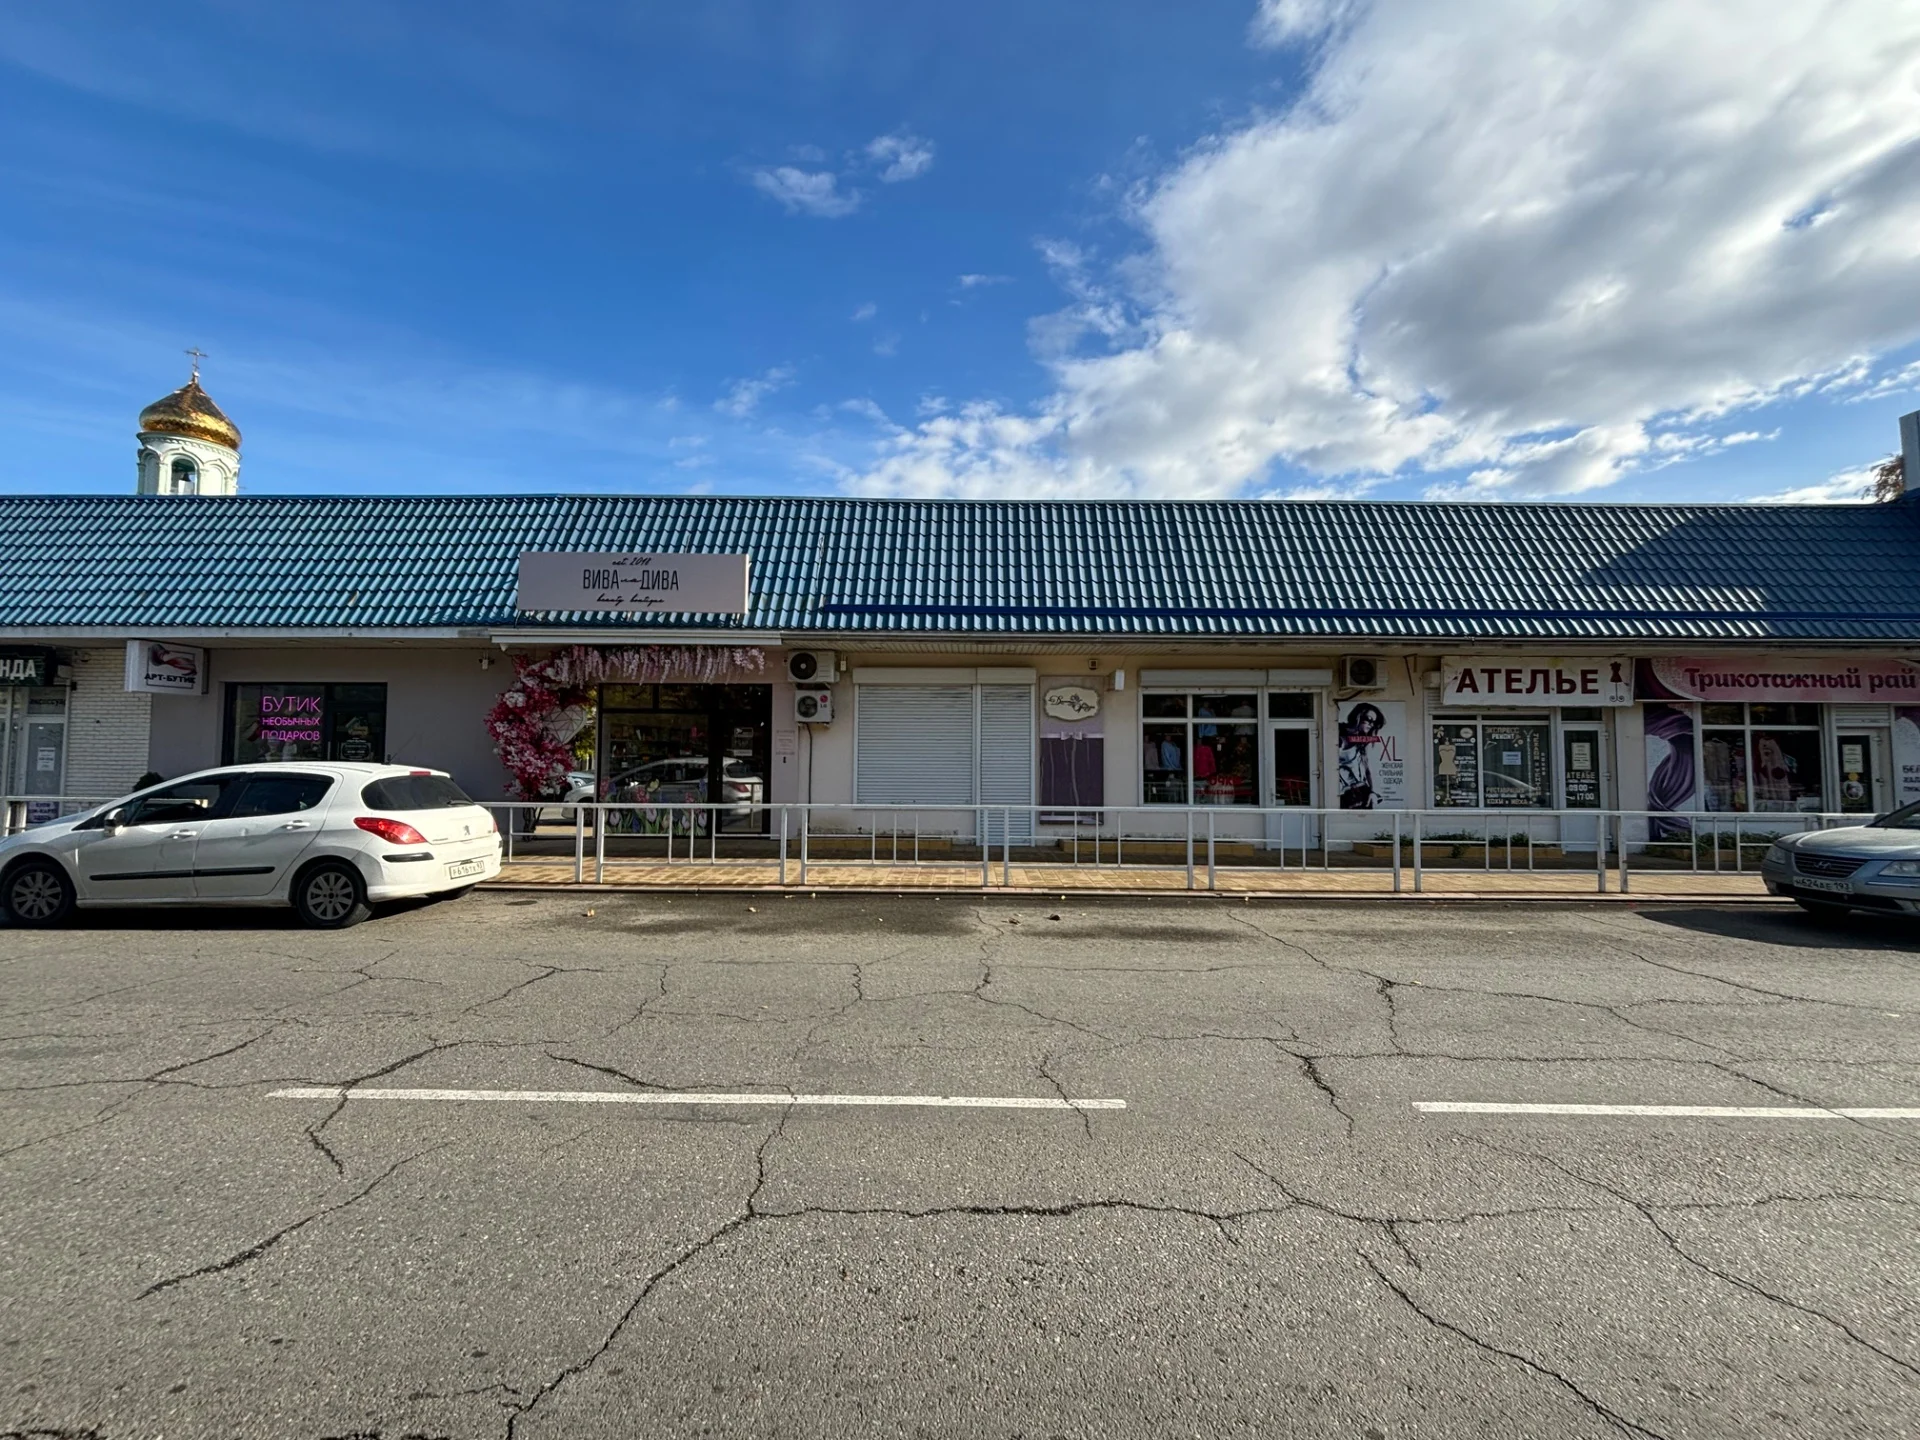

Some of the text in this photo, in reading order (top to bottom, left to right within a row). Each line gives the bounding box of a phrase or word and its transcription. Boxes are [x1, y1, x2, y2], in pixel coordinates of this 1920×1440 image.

[583, 569, 619, 589] ВИВА
[640, 570, 679, 591] ДИВА
[0, 659, 37, 680] НДА
[144, 672, 196, 684] АРТ-БУТИК
[1684, 667, 1917, 693] Трикотажный рай
[1456, 668, 1599, 694] АТЕЛЬЕ
[262, 696, 321, 712] БУТИК
[262, 716, 320, 726] НЕОБЫЧНЫХ
[261, 730, 320, 741] ПОДАРКОВ
[1379, 735, 1403, 761] XL
